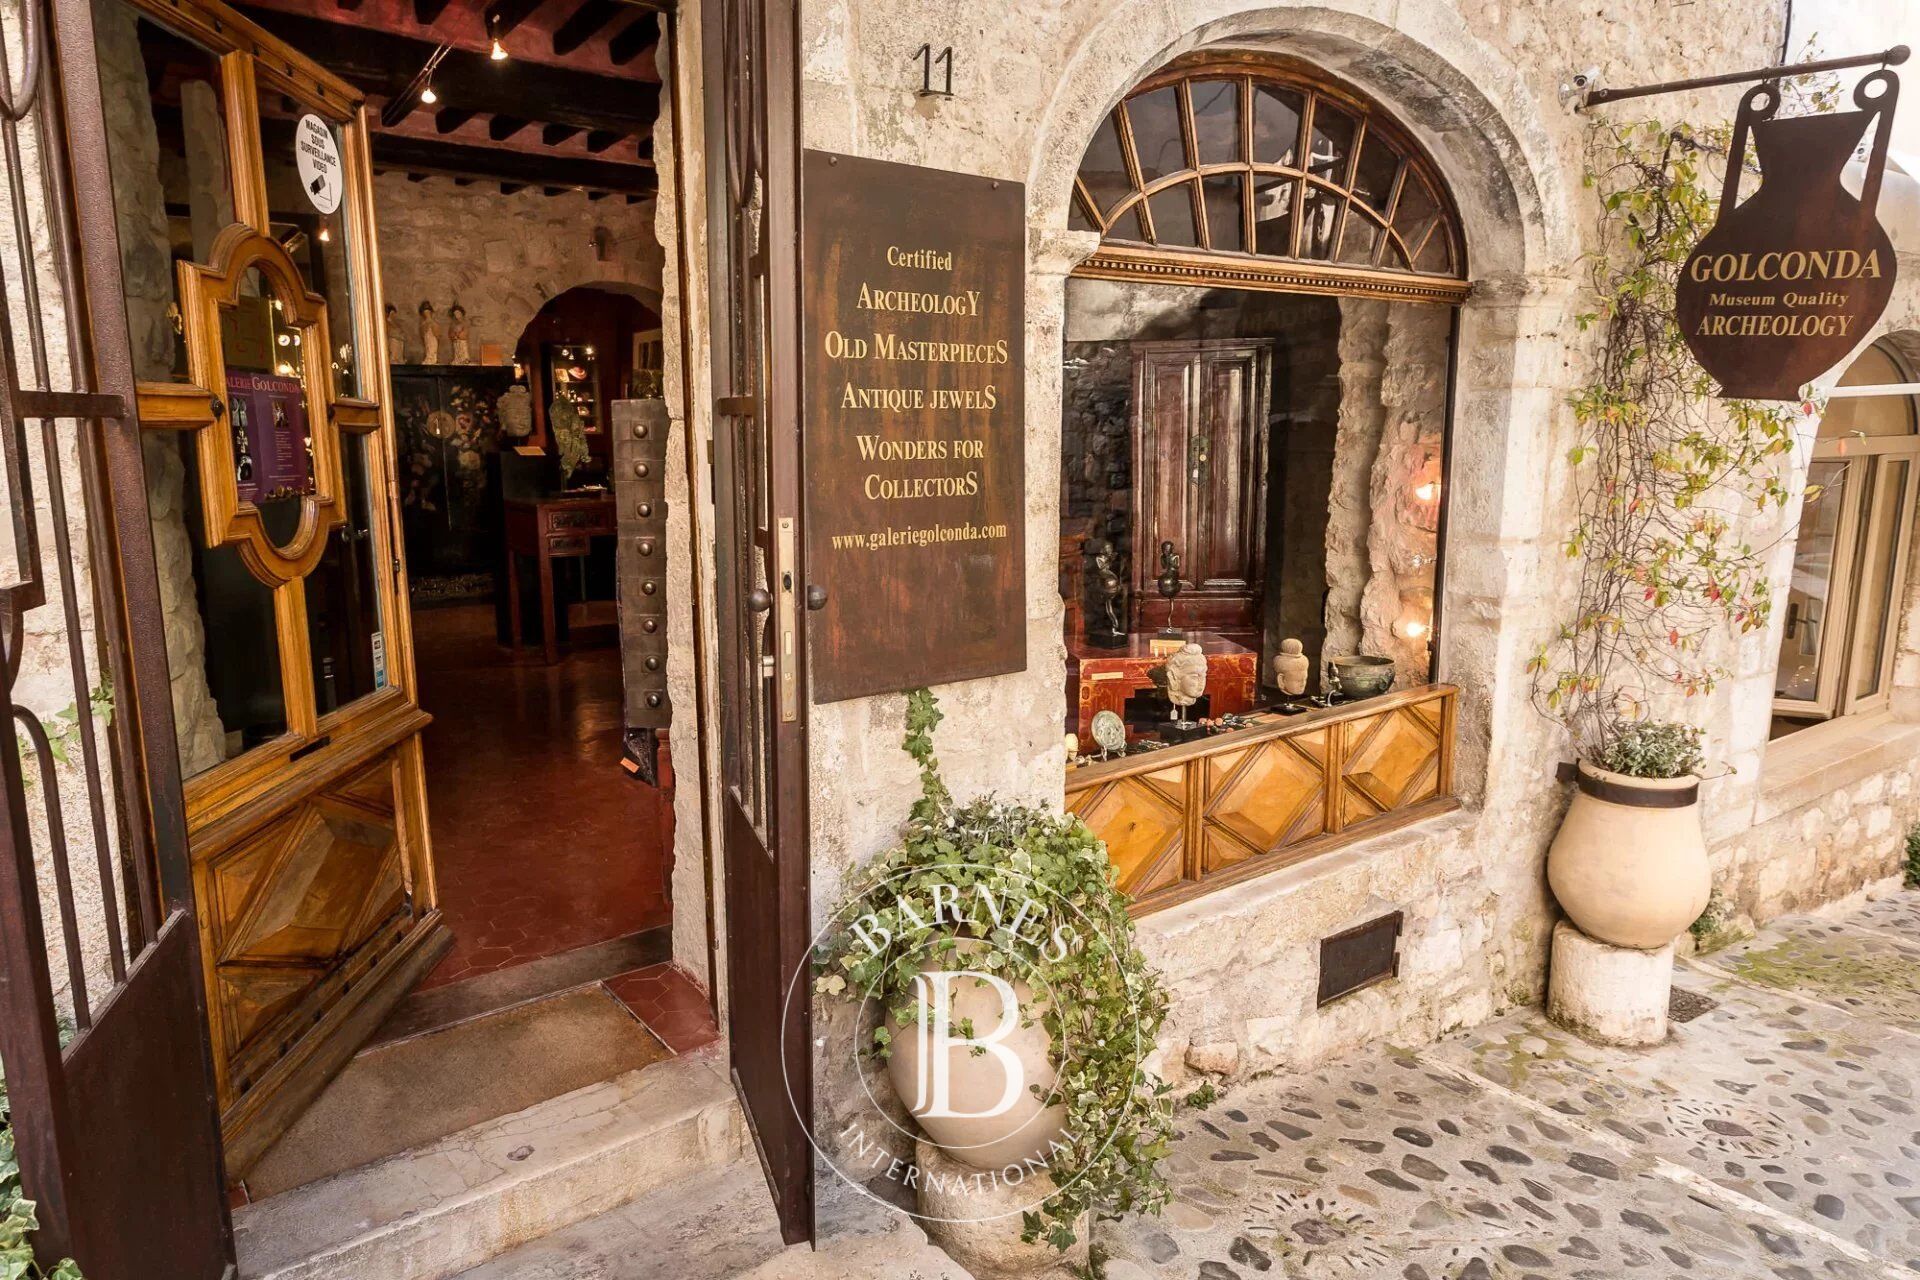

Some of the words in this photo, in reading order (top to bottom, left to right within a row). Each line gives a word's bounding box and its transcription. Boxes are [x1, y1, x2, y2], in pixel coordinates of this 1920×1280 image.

[913, 42, 954, 99] 11
[305, 119, 328, 139] MAGASIN
[311, 134, 325, 150] SOUS
[300, 140, 337, 167] SURVEILLANCE
[886, 245, 953, 272] Certified
[1690, 248, 1883, 282] GOLCONDA
[857, 282, 981, 317] ARCHEOLOGY
[1708, 292, 1775, 307] Museum
[1782, 291, 1850, 308] Quality
[1695, 314, 1854, 337] ARCHEOLOGY
[824, 330, 868, 359] OLD
[874, 332, 1009, 365] MASTERPIECES
[841, 382, 924, 413] ANTIQUE
[929, 384, 997, 410] JEWELS
[855, 435, 948, 461] WONDERS
[953, 440, 984, 459] FOR
[864, 470, 978, 500] COLLECTORS
[831, 521, 1008, 551] www.galeriegolconda.com
